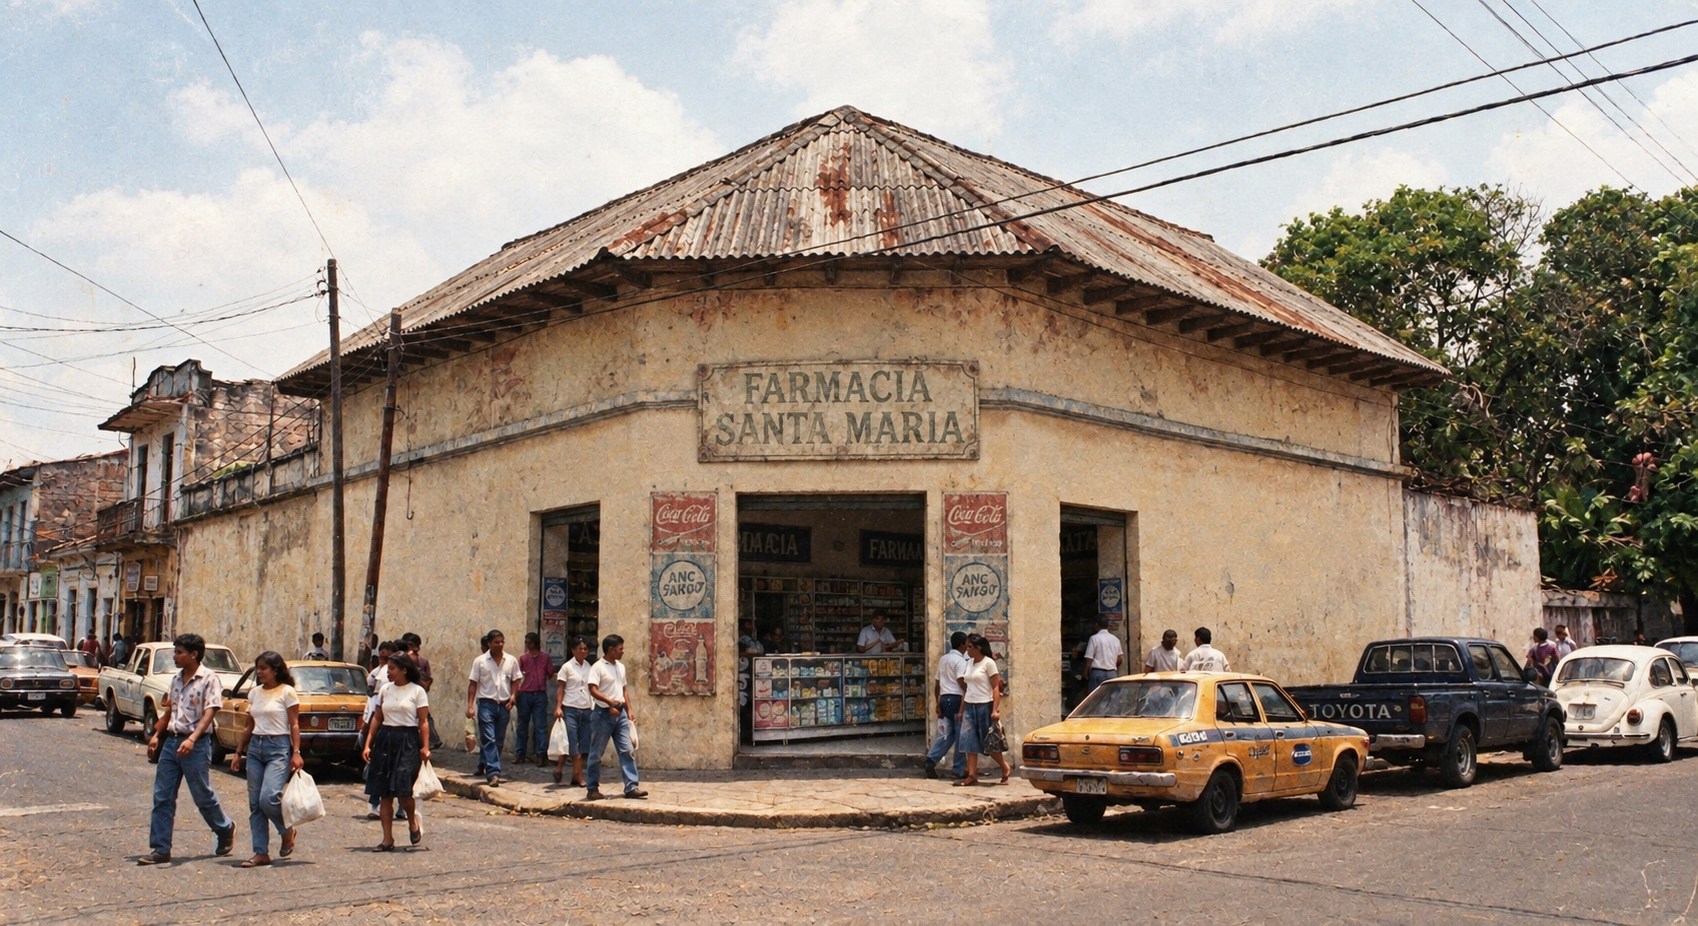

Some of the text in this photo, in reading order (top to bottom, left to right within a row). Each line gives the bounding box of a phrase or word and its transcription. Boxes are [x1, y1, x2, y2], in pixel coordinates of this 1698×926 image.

[744, 370, 933, 404] FARMACIA
[715, 410, 966, 446] SANTA MARIA
[1308, 703, 1392, 719] TOYOTA
